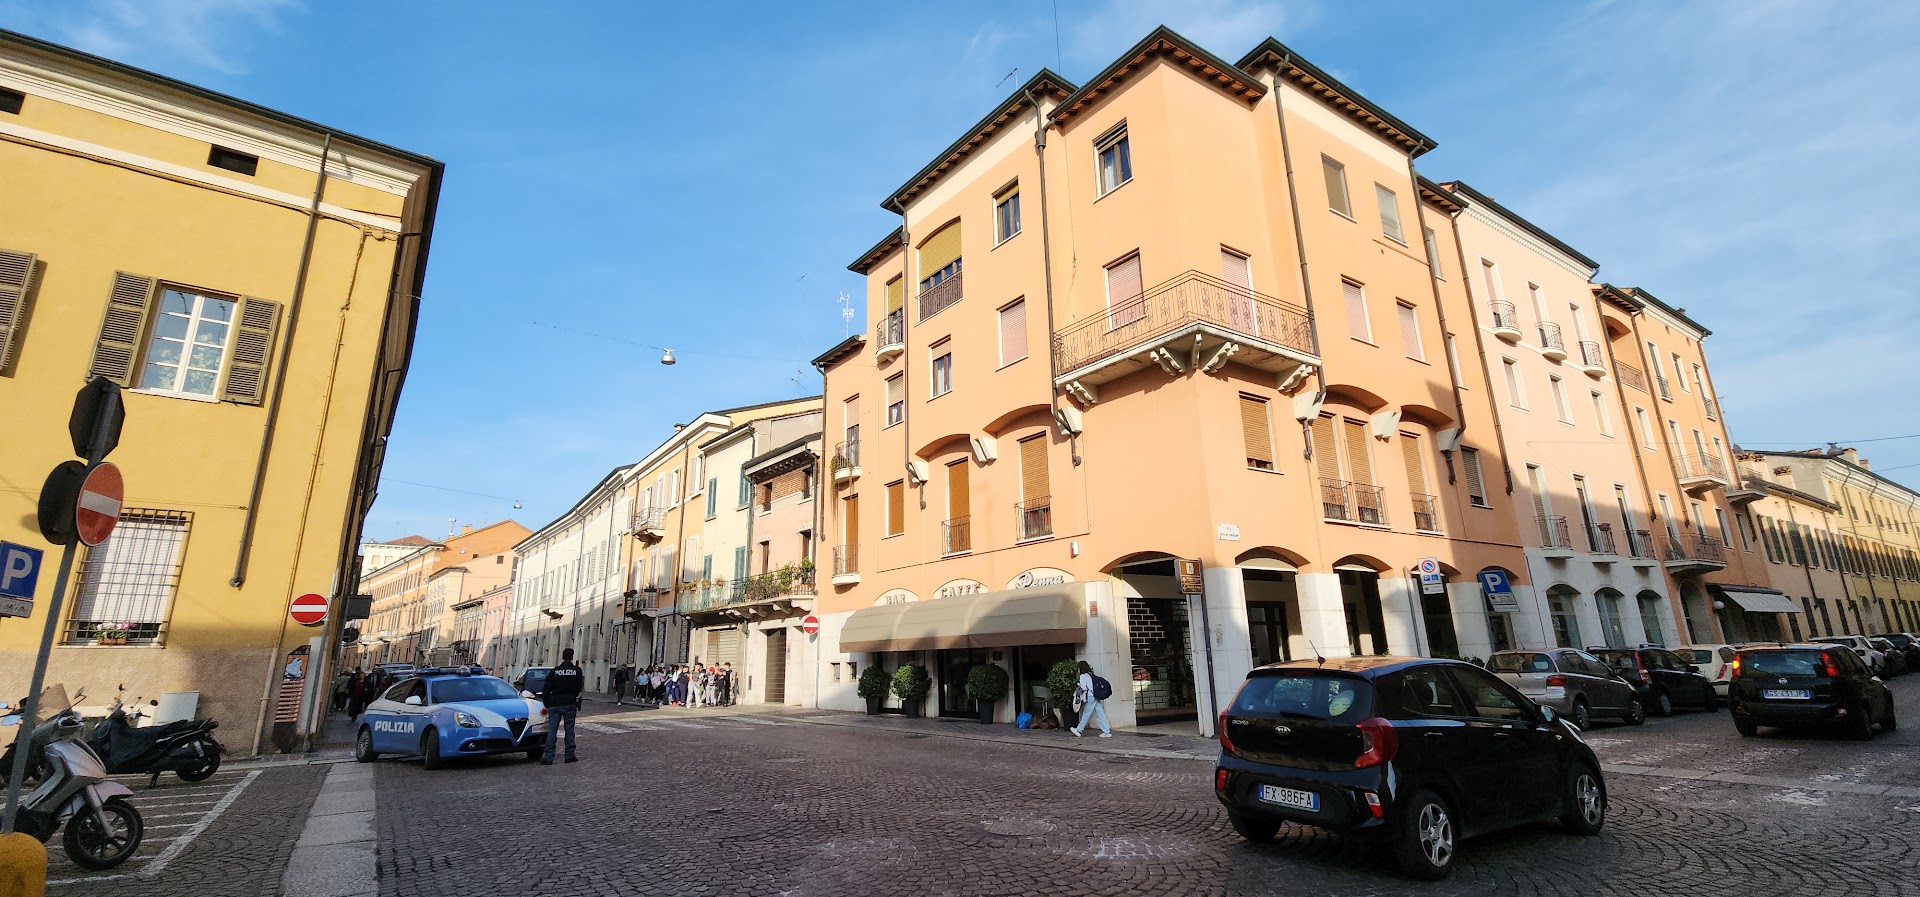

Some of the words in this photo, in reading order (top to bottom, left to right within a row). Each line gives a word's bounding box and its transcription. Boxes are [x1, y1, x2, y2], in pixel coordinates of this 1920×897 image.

[1, 548, 33, 590] P
[1484, 573, 1502, 592] P
[885, 593, 906, 605] BAR
[374, 720, 415, 733] POLIZIA
[1265, 786, 1276, 800] FX
[1281, 789, 1311, 806] 986FA
